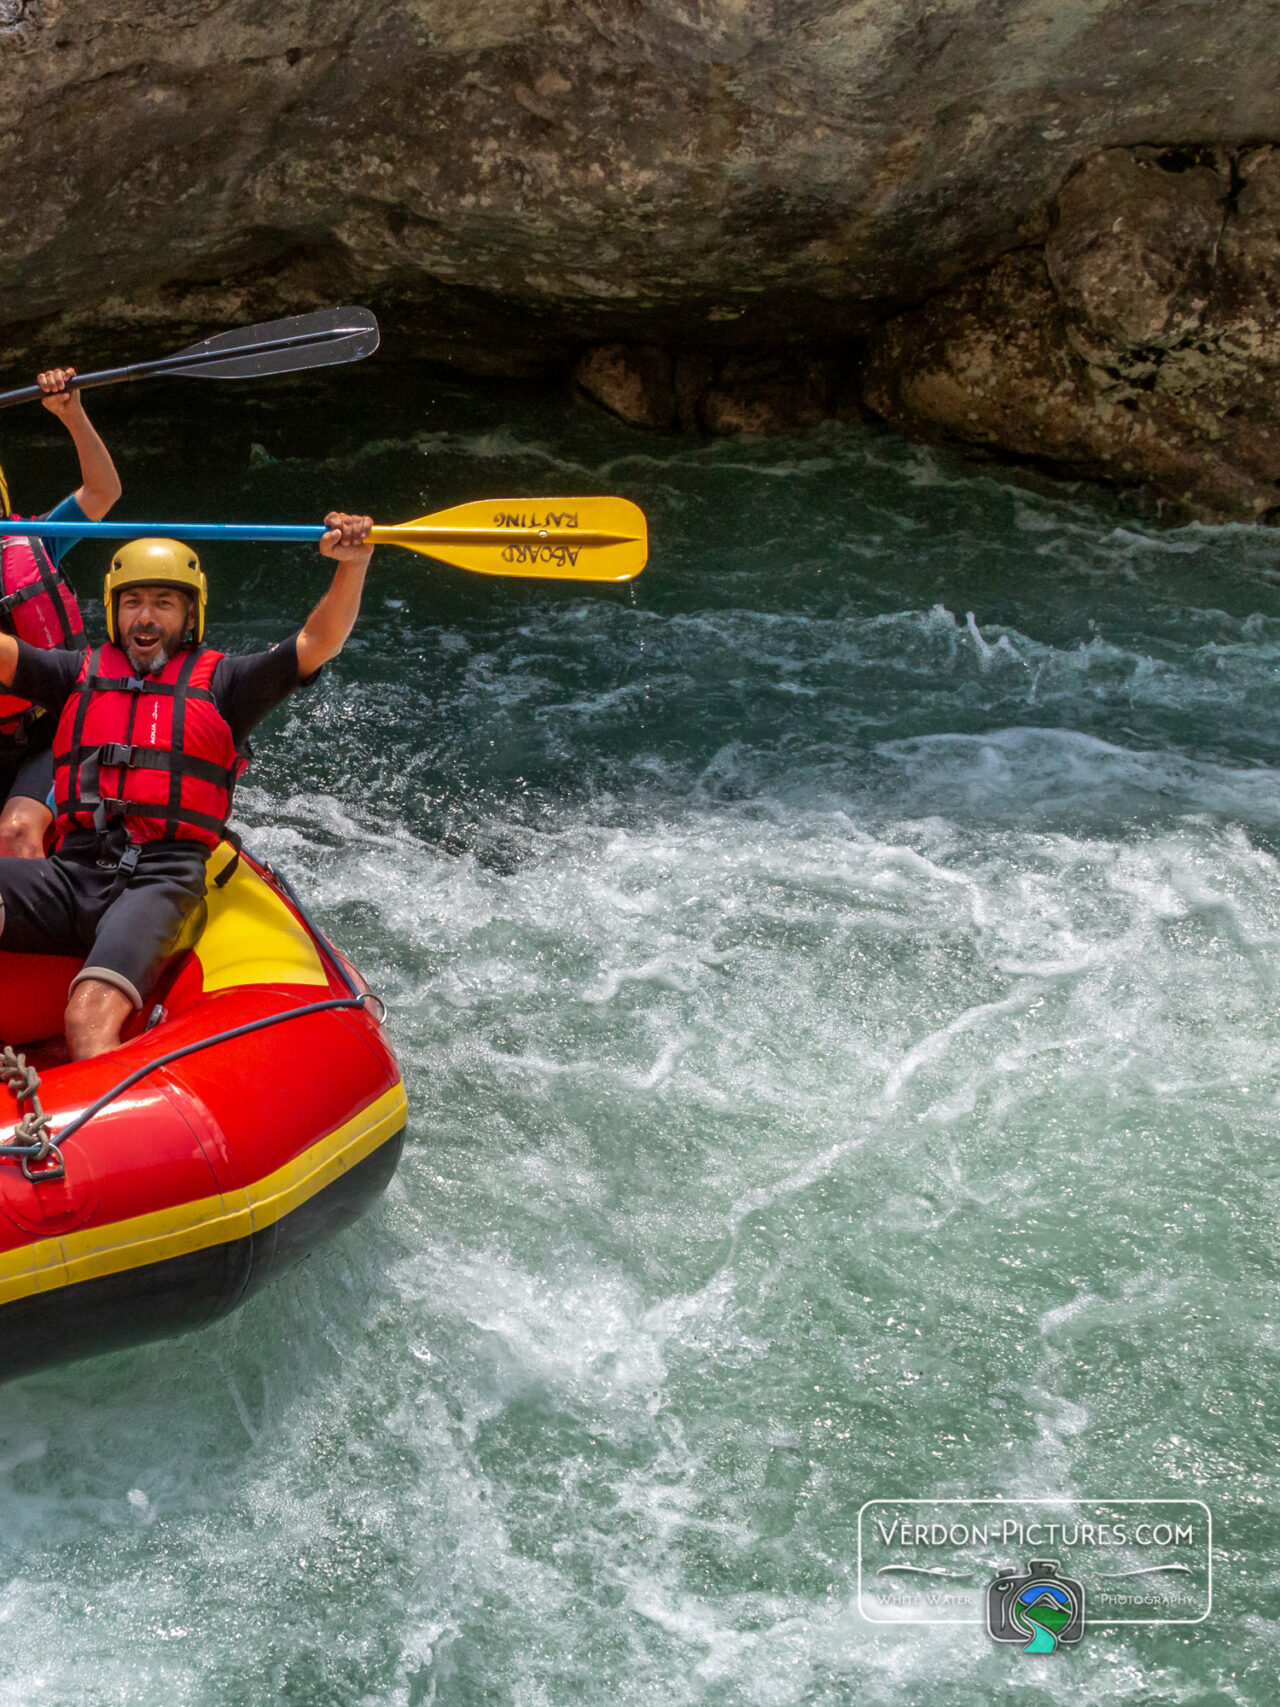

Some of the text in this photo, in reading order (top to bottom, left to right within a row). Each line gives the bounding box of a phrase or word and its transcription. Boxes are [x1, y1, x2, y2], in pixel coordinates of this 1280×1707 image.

[493, 512, 579, 528] RAFTING
[501, 545, 582, 567] ABOARD
[146, 723, 157, 744] AQUA
